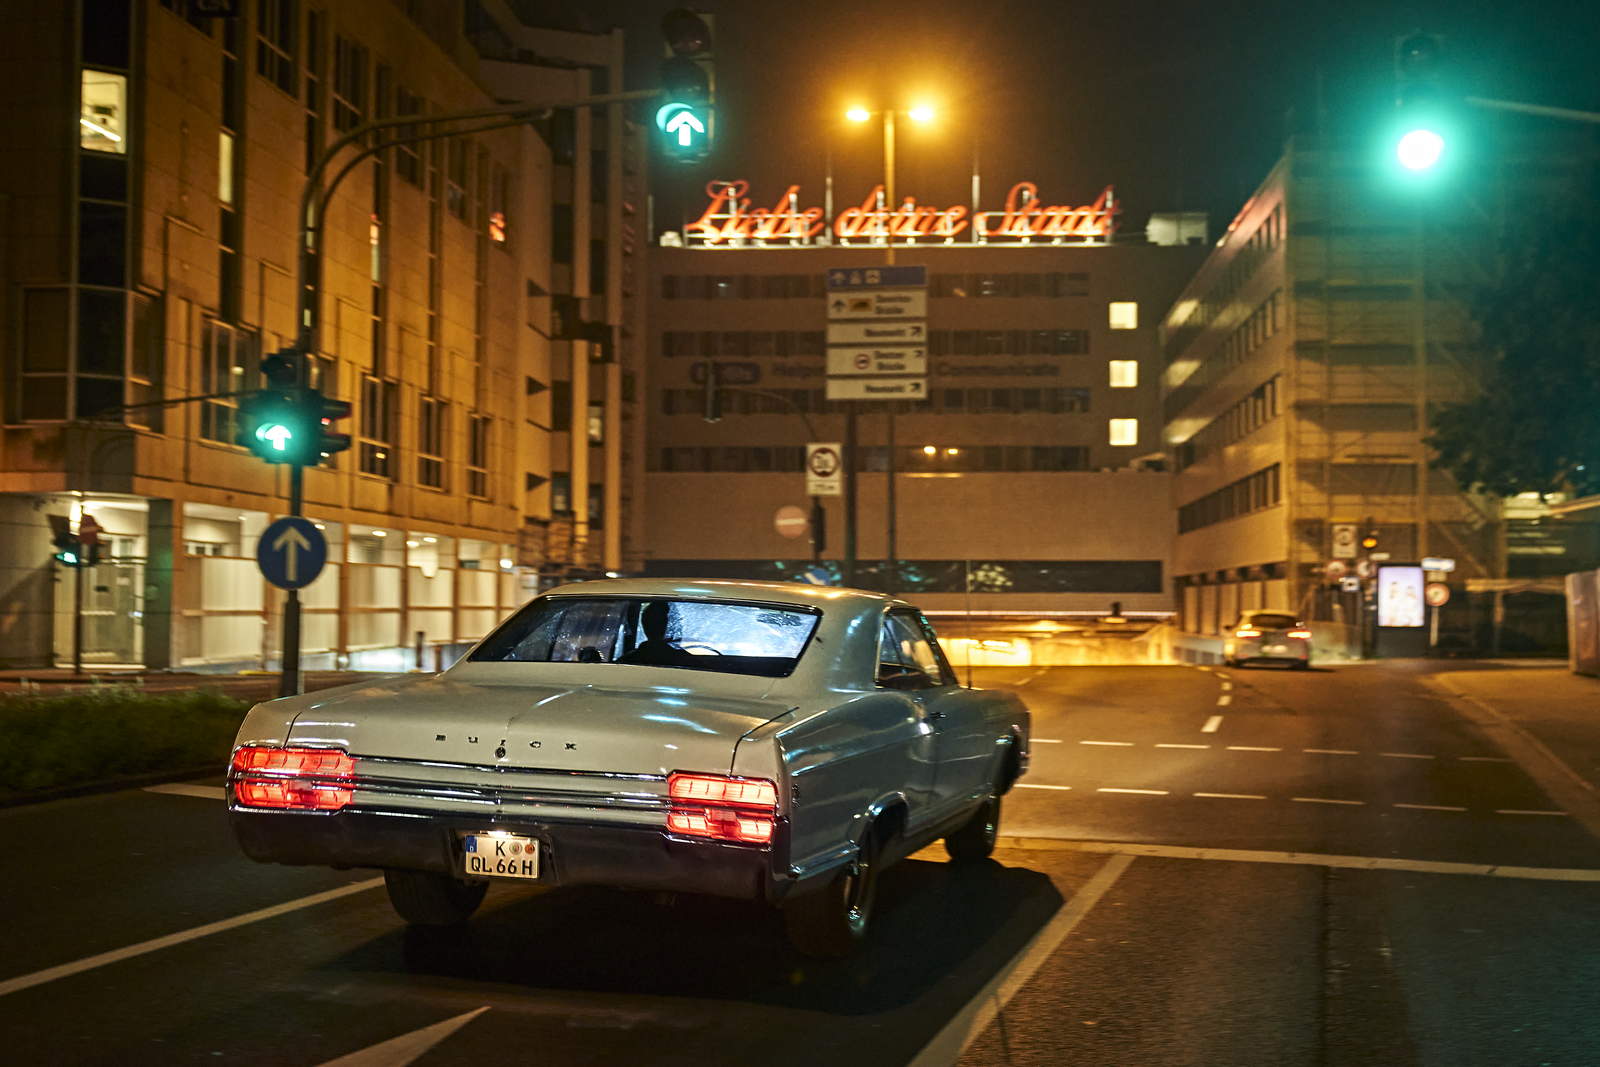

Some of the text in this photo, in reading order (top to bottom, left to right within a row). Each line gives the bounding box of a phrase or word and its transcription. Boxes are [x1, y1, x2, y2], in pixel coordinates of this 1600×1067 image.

[684, 180, 1121, 242] Liebe deine Stadt
[495, 840, 506, 857] K
[471, 856, 493, 873] QL
